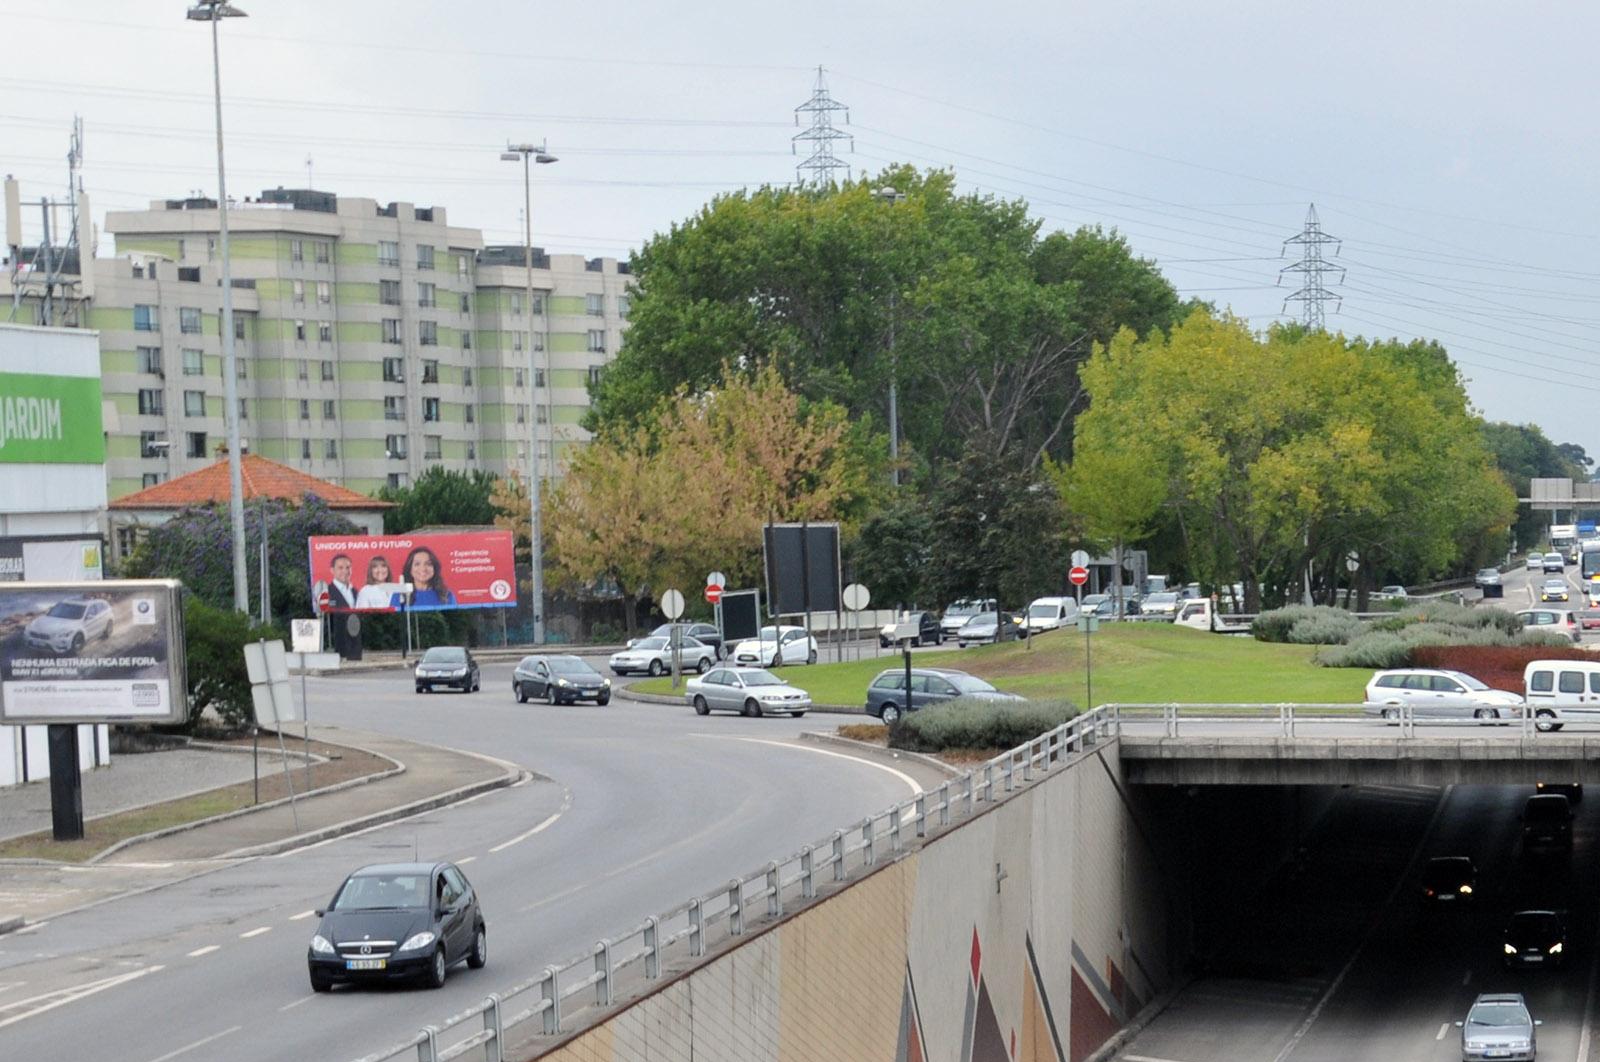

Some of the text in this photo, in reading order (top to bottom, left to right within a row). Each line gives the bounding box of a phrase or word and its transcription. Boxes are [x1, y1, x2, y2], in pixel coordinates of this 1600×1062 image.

[315, 542, 347, 550] UNIDOS
[348, 541, 369, 550] PARA
[379, 540, 413, 549] FUTURO
[56, 658, 98, 667] ESTRADA
